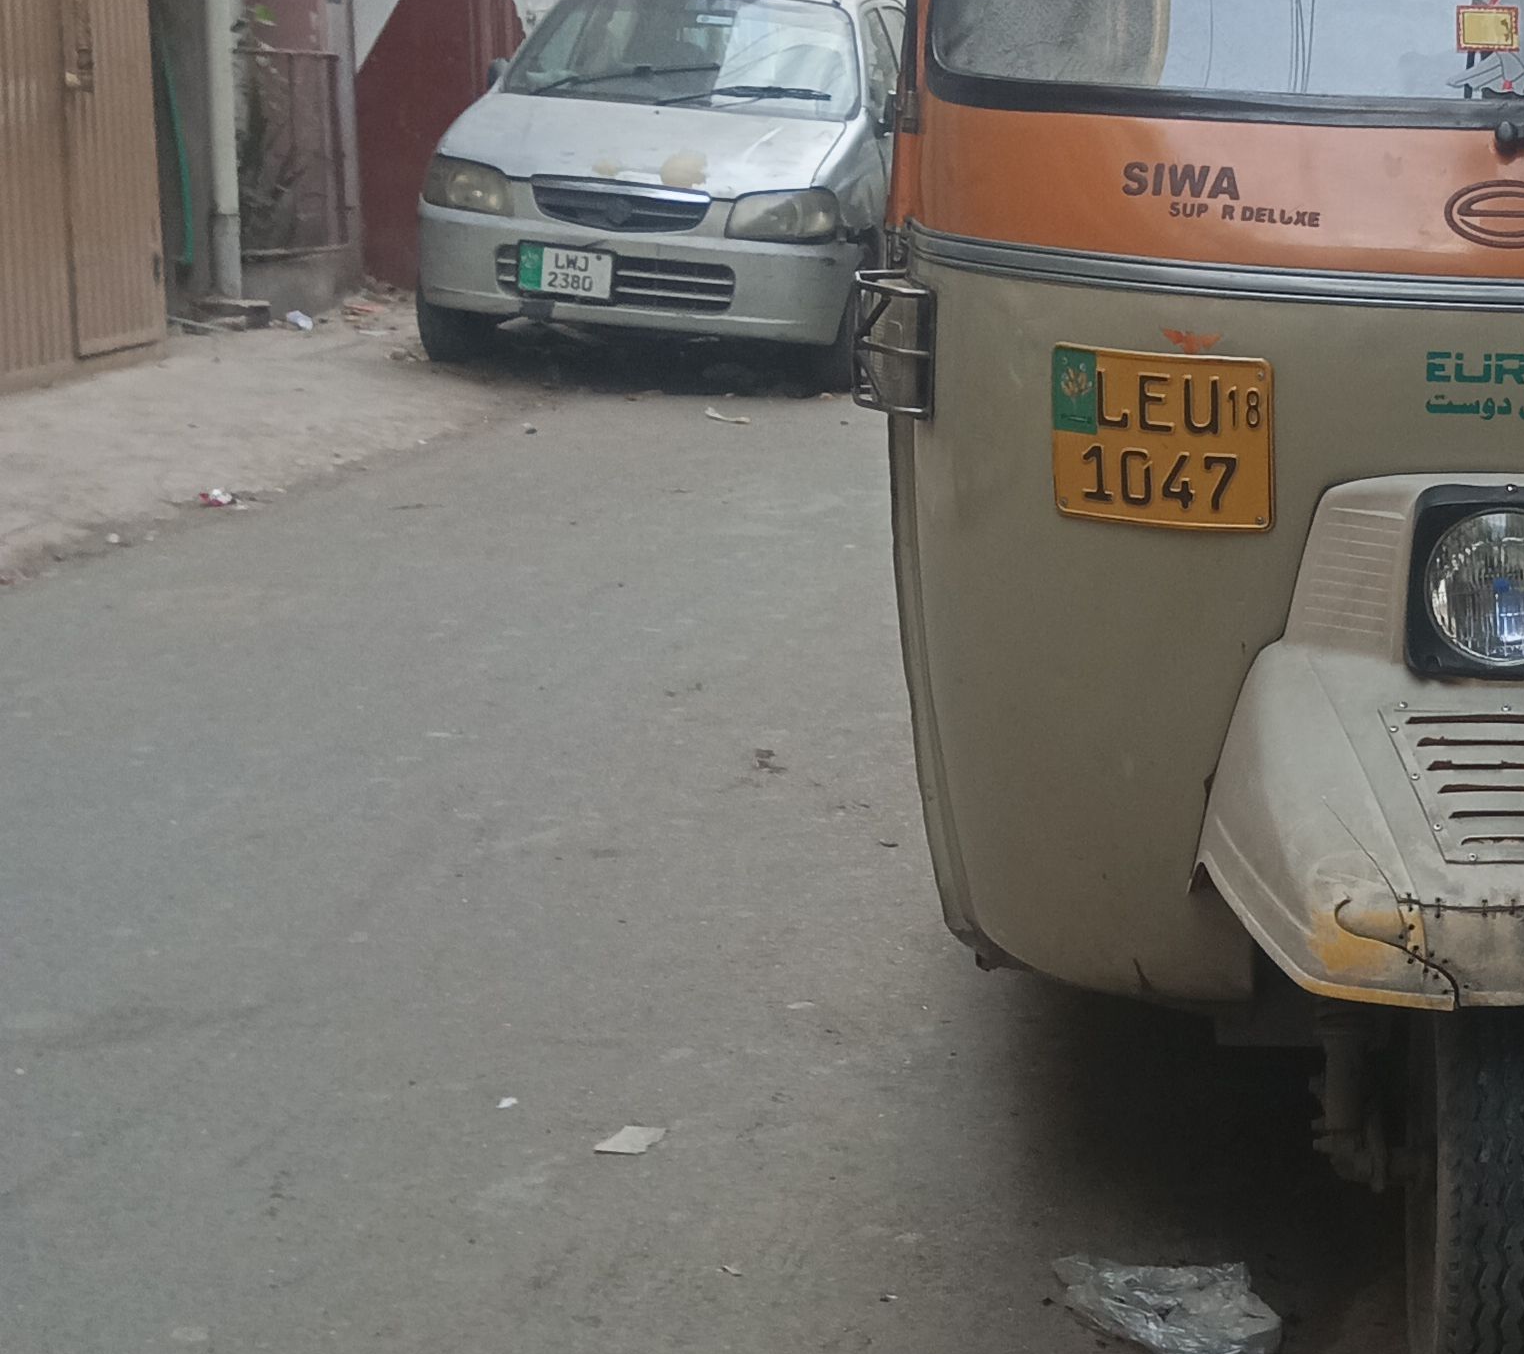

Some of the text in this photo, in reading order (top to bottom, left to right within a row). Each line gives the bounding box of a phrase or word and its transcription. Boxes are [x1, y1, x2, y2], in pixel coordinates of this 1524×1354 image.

[1122, 162, 1241, 201] SIWA
[554, 253, 590, 272] LWJ
[547, 271, 594, 292] 2380
[1096, 367, 1262, 435] LEU 18
[1425, 394, 1512, 421] دوست
[1081, 443, 1238, 511] 1047
